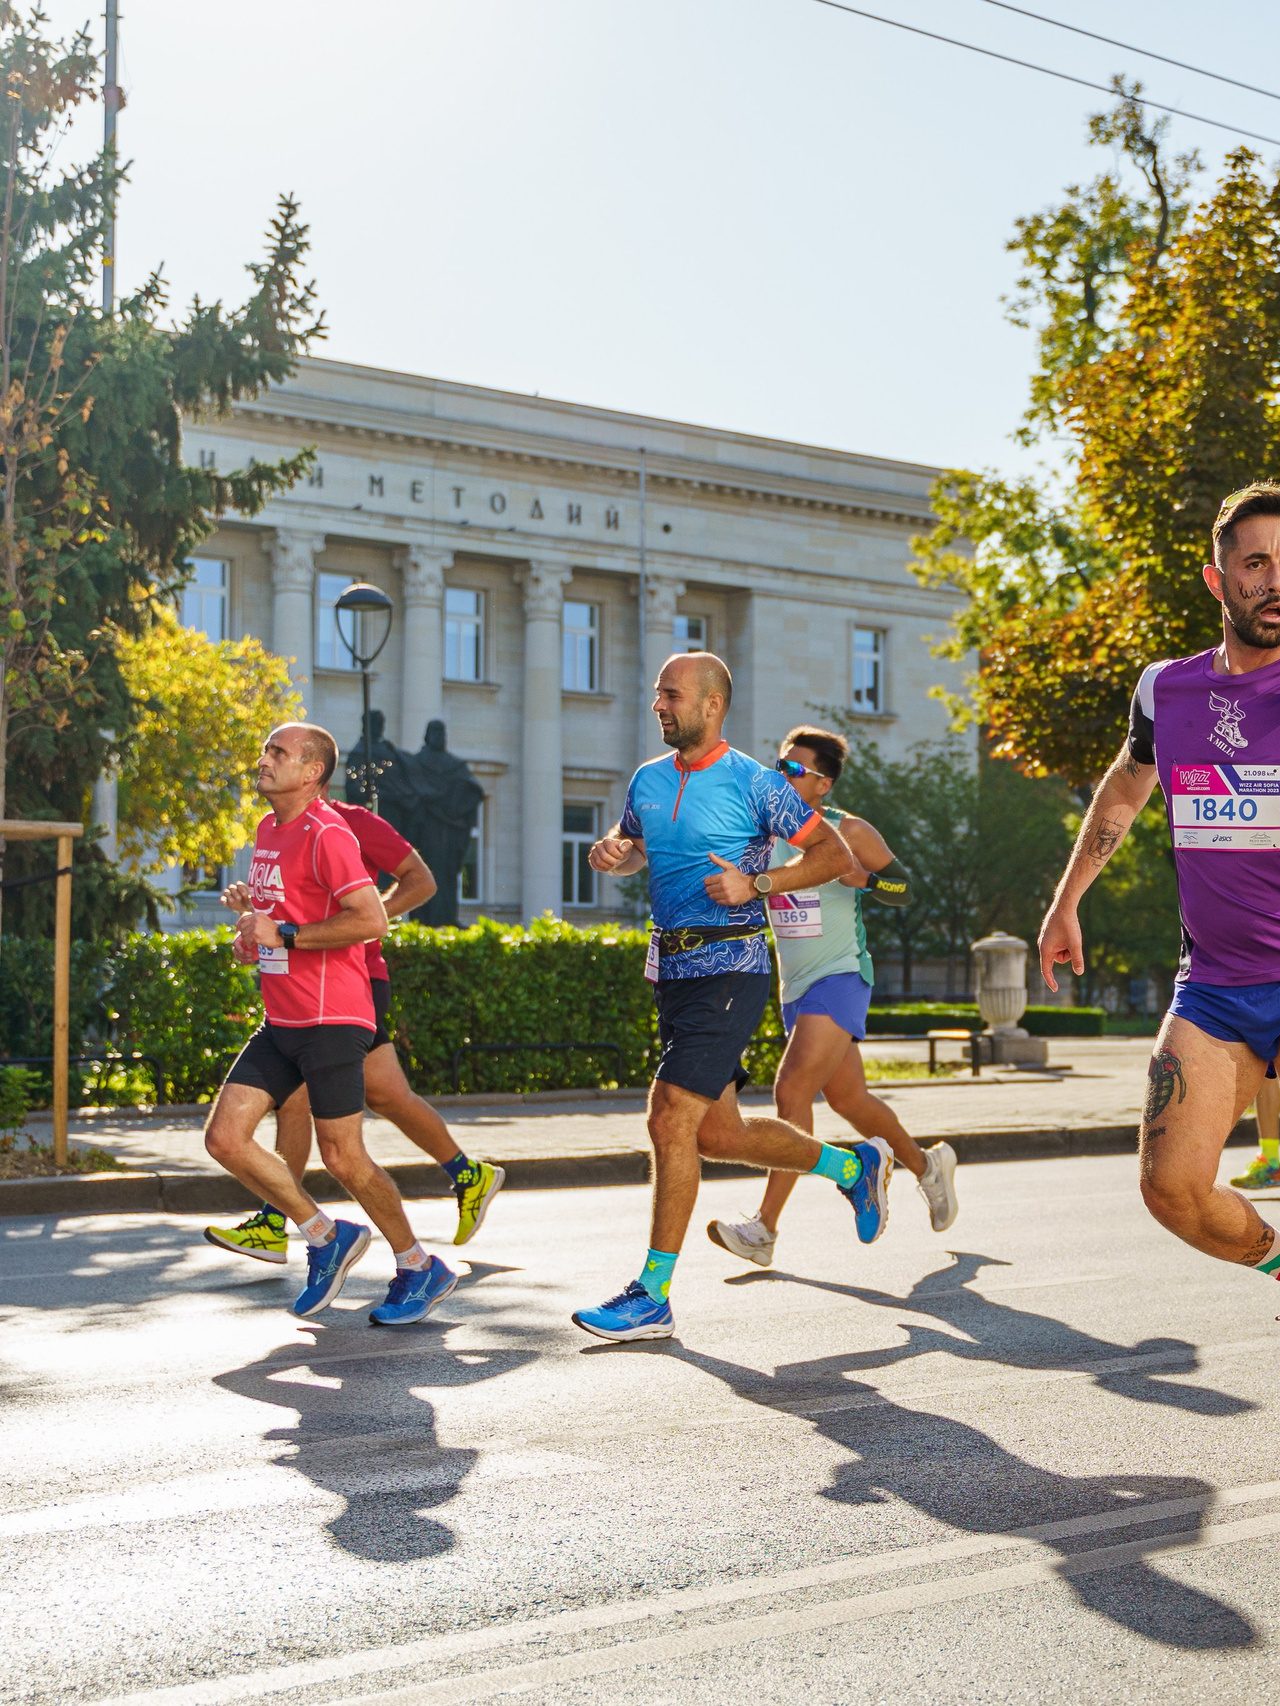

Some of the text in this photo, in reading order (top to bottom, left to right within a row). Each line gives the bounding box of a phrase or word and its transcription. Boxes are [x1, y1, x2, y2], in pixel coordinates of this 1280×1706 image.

[369, 474, 620, 531] МЕТОДИЙ
[1206, 733, 1216, 742] X
[1192, 798, 1258, 821] 1840
[778, 910, 808, 923] 1369
